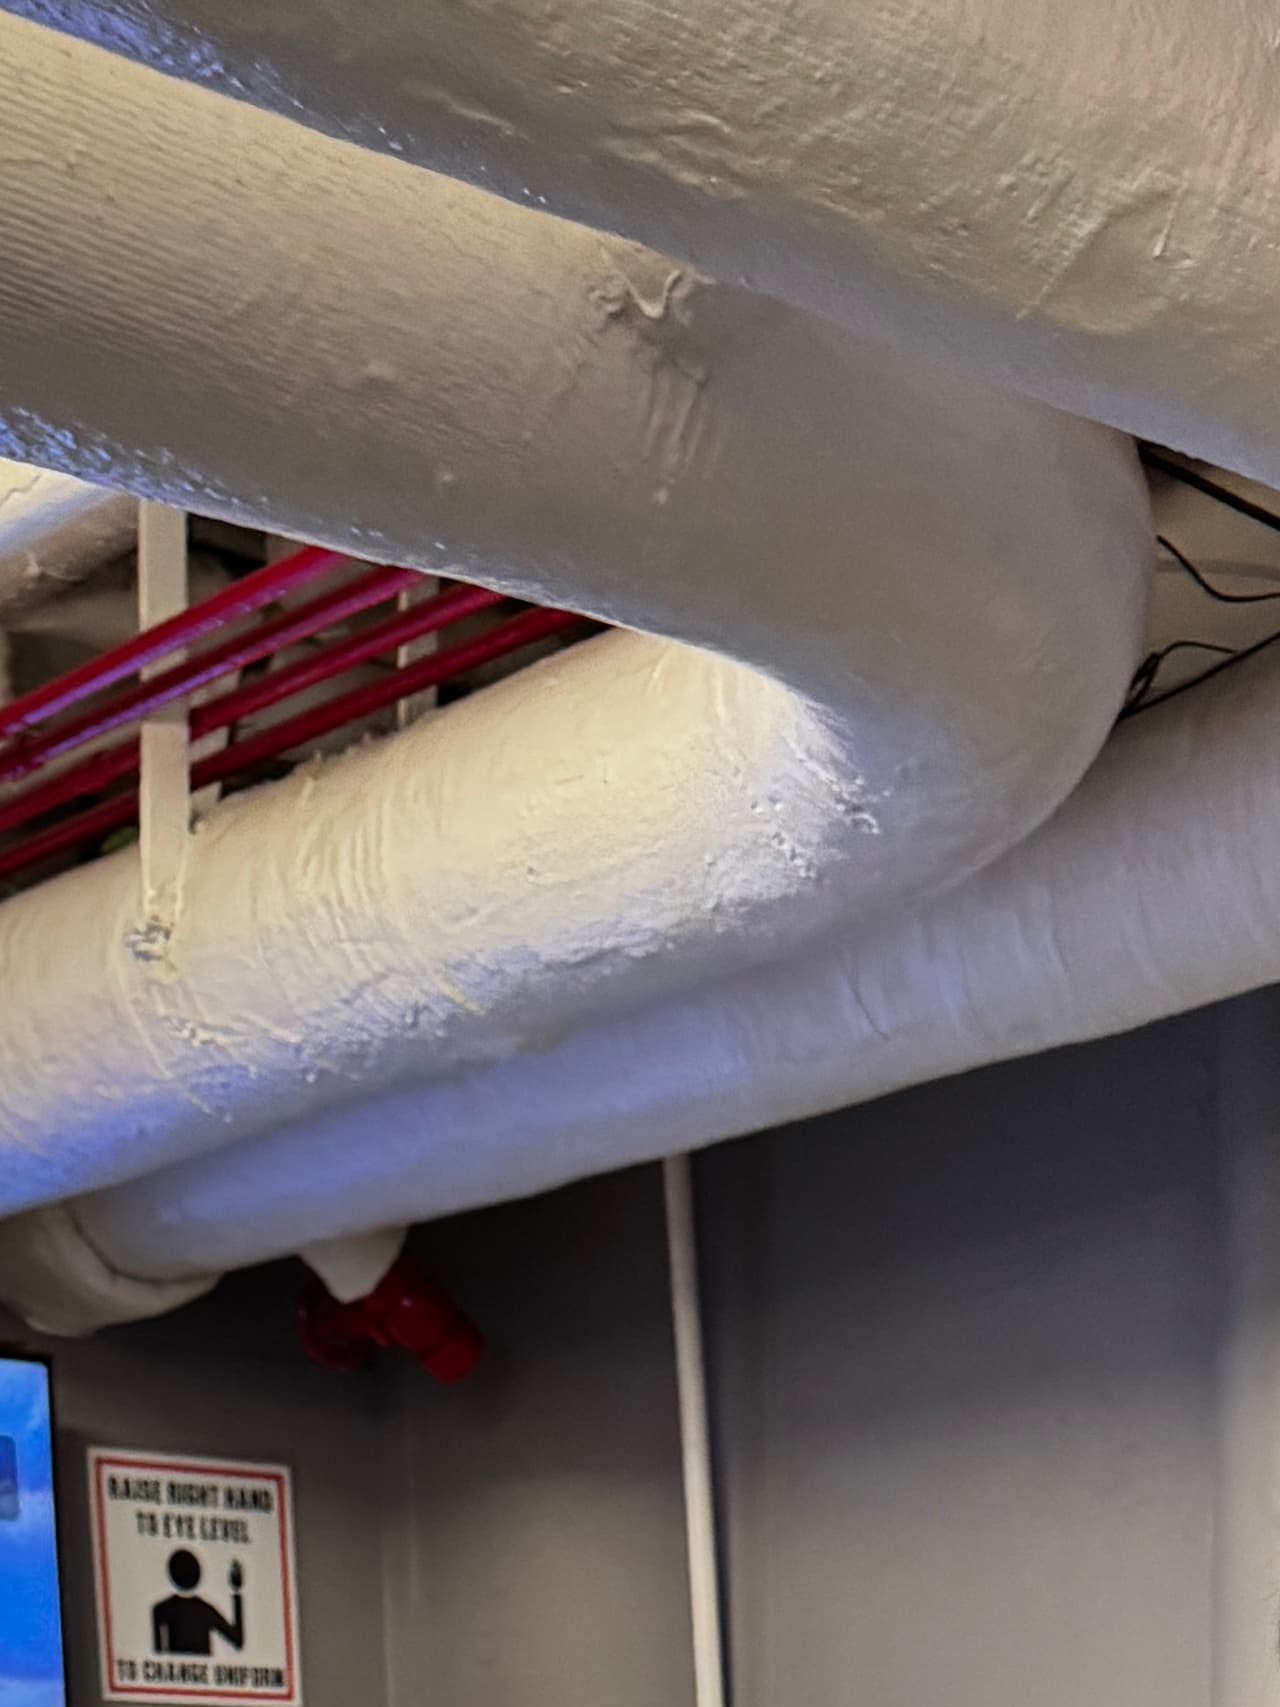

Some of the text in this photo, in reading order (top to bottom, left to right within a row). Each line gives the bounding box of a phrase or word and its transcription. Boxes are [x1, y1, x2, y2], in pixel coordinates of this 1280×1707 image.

[136, 1510, 159, 1537] TO
[163, 1513, 196, 1540] EYE
[117, 1659, 137, 1682] TO
